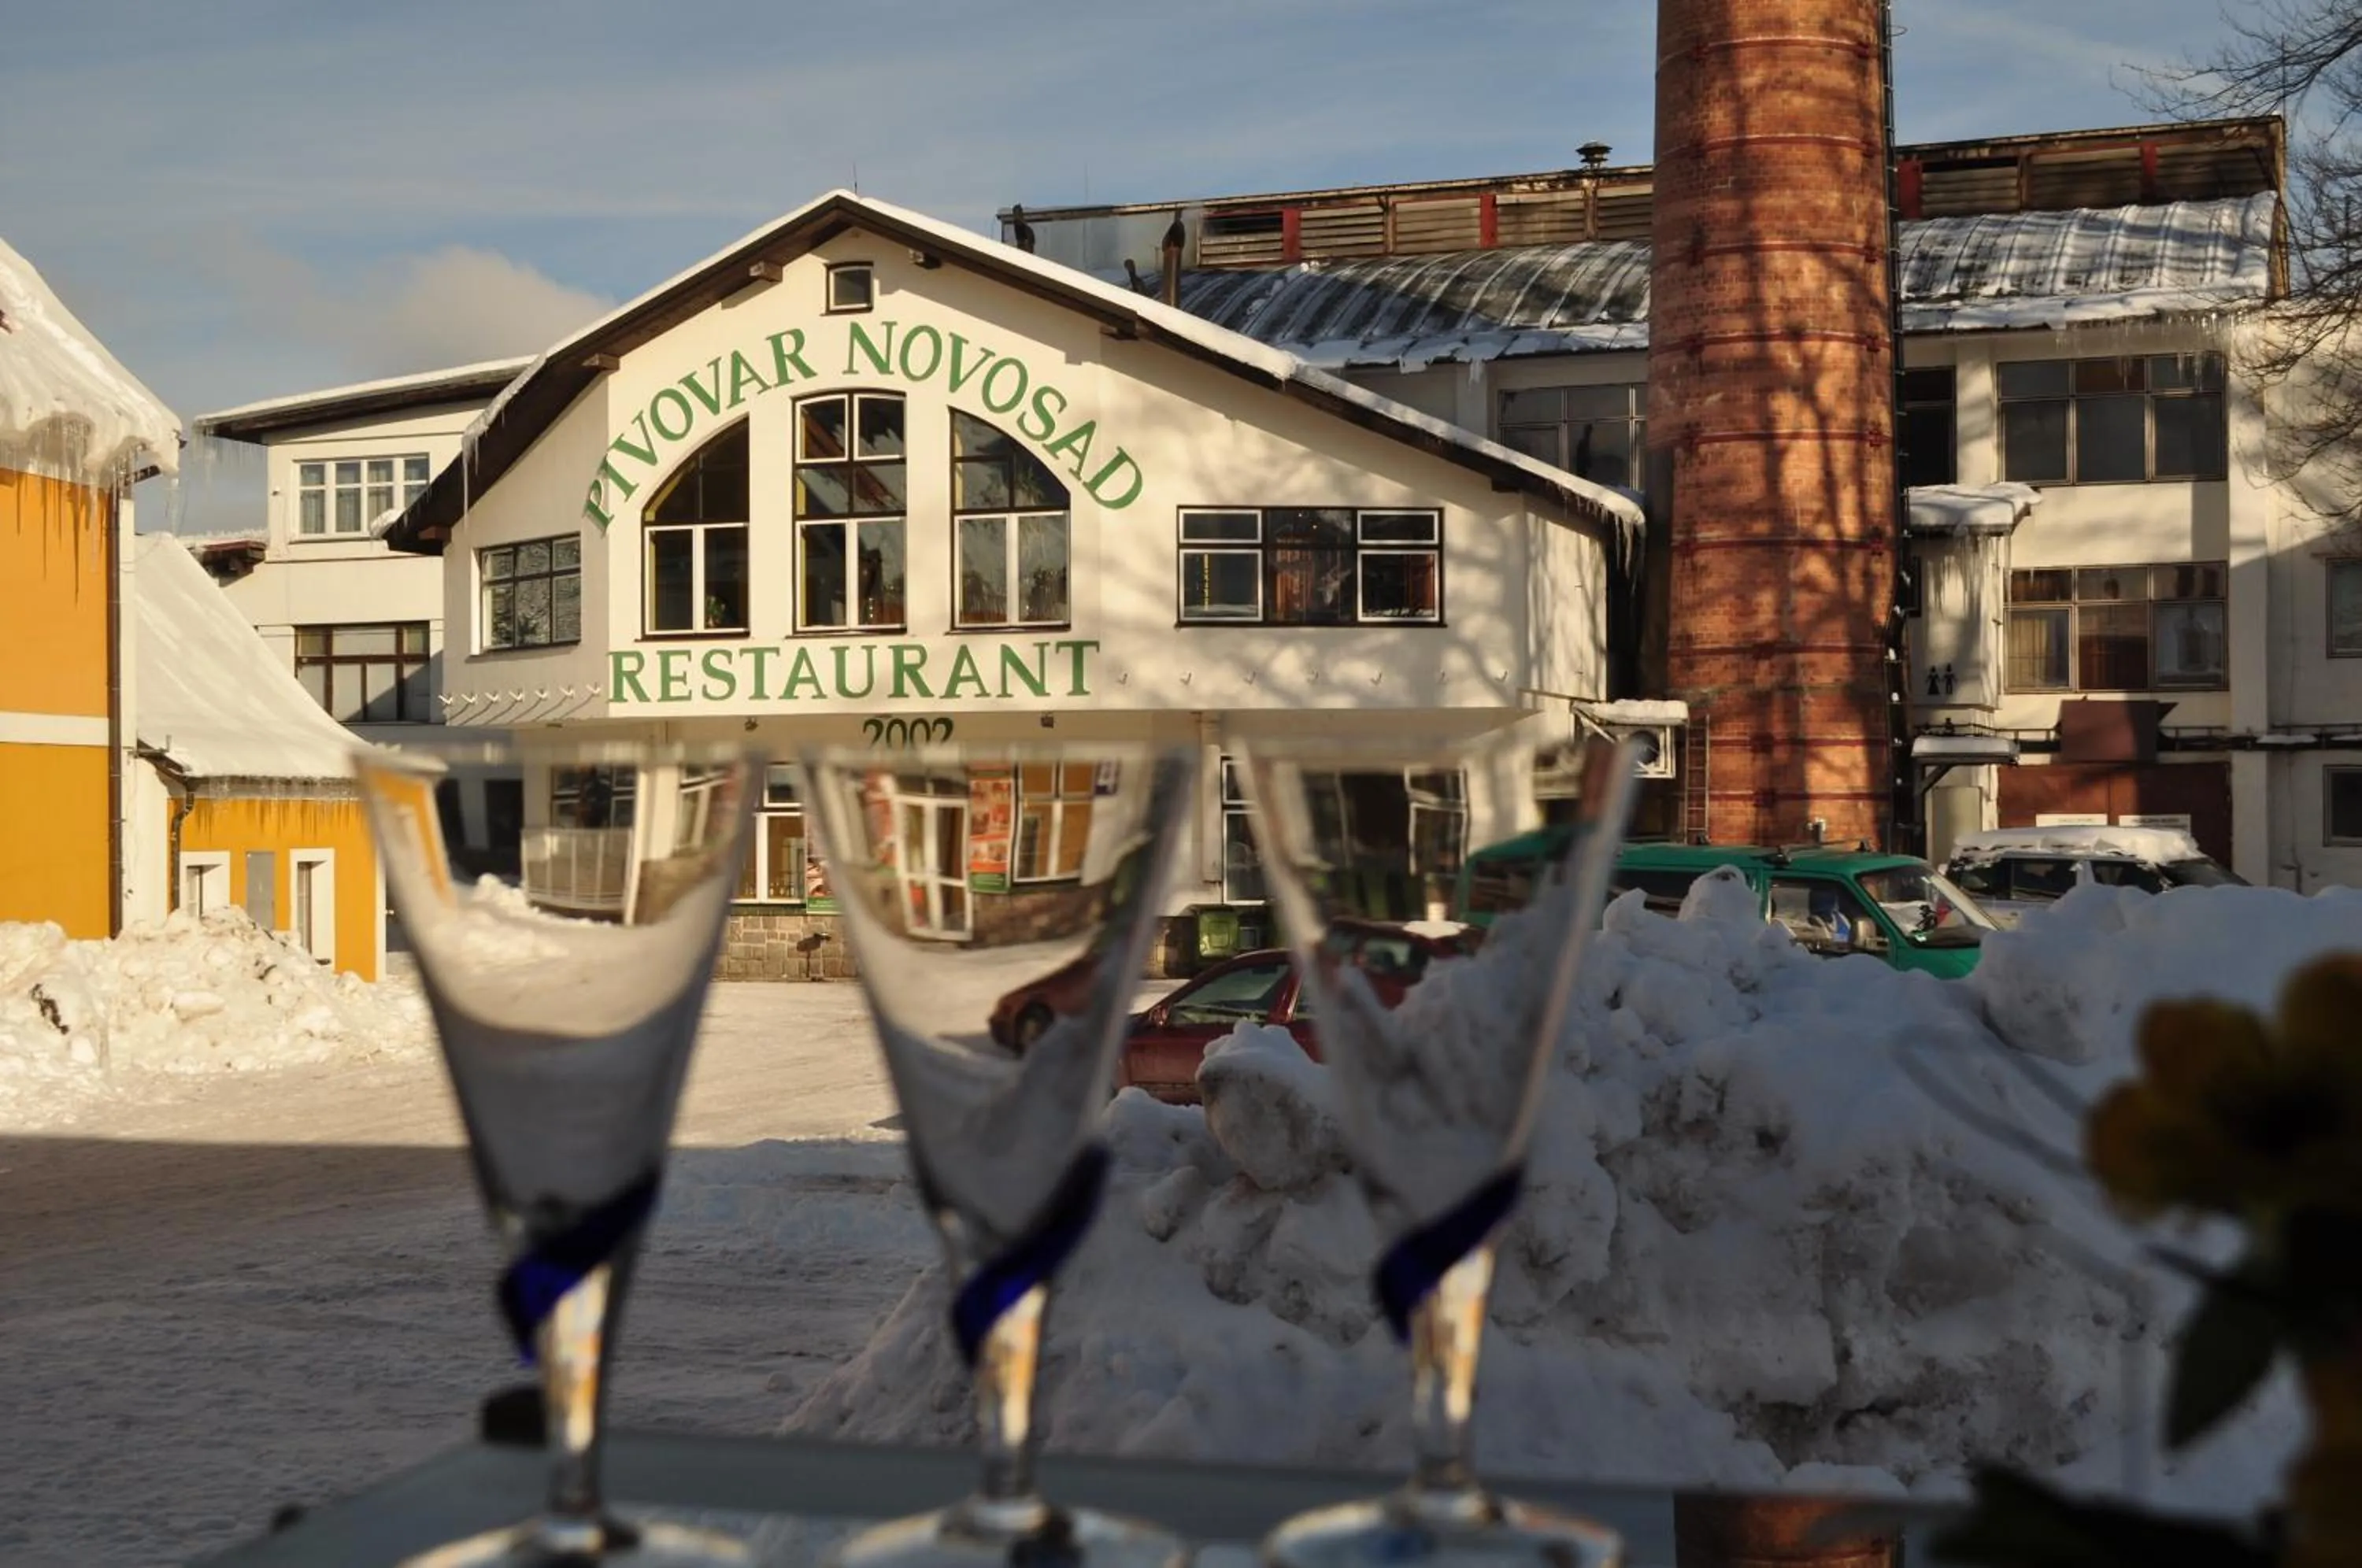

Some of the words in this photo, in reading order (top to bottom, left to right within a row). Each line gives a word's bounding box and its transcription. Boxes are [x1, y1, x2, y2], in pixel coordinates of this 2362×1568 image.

[582, 327, 817, 538] PIVOVAR
[842, 320, 1143, 510] NOVOSAD
[607, 640, 1100, 703] RESTAURANT
